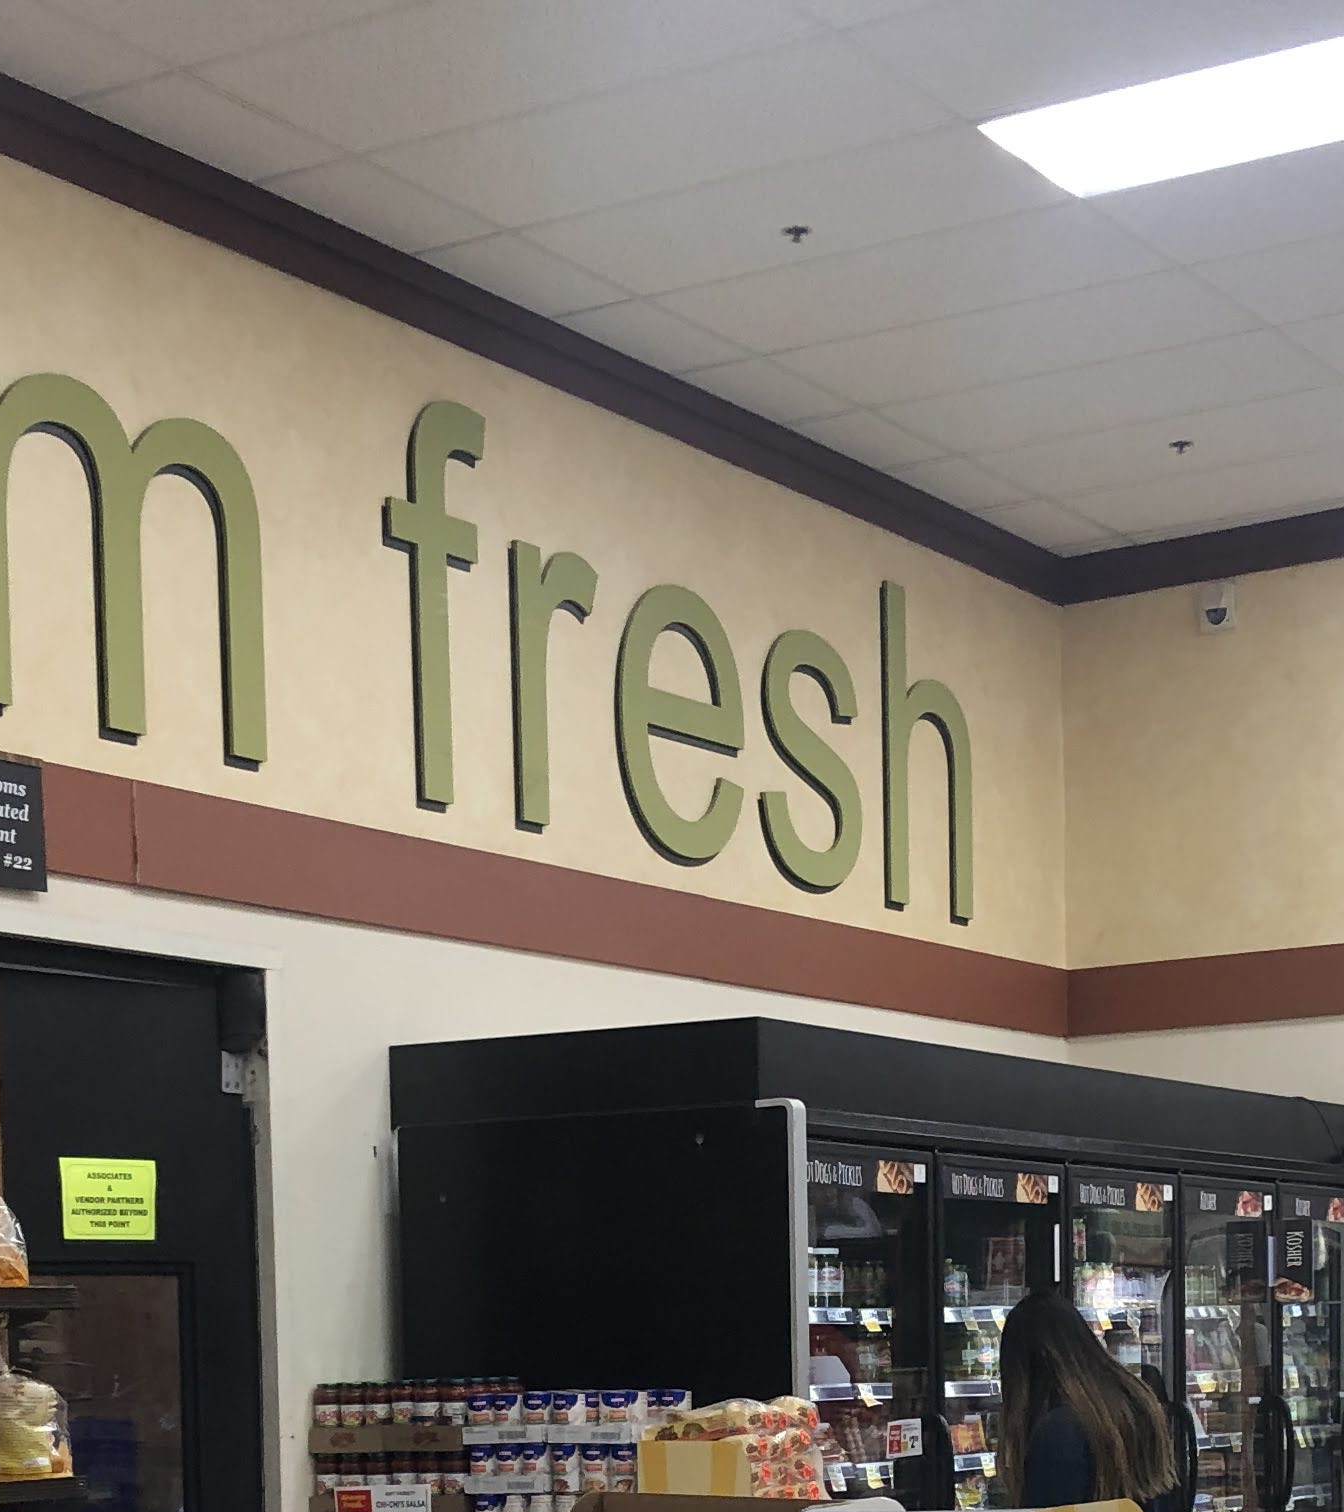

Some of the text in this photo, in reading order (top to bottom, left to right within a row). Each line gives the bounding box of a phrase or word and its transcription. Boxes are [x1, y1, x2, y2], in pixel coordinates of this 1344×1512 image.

[383, 400, 974, 926] fresh
[3, 853, 32, 872] #22
[87, 1172, 132, 1180] ASSOCIATES
[71, 1208, 117, 1216] AUTHORIZED
[1287, 1231, 1305, 1268] KOSHER
